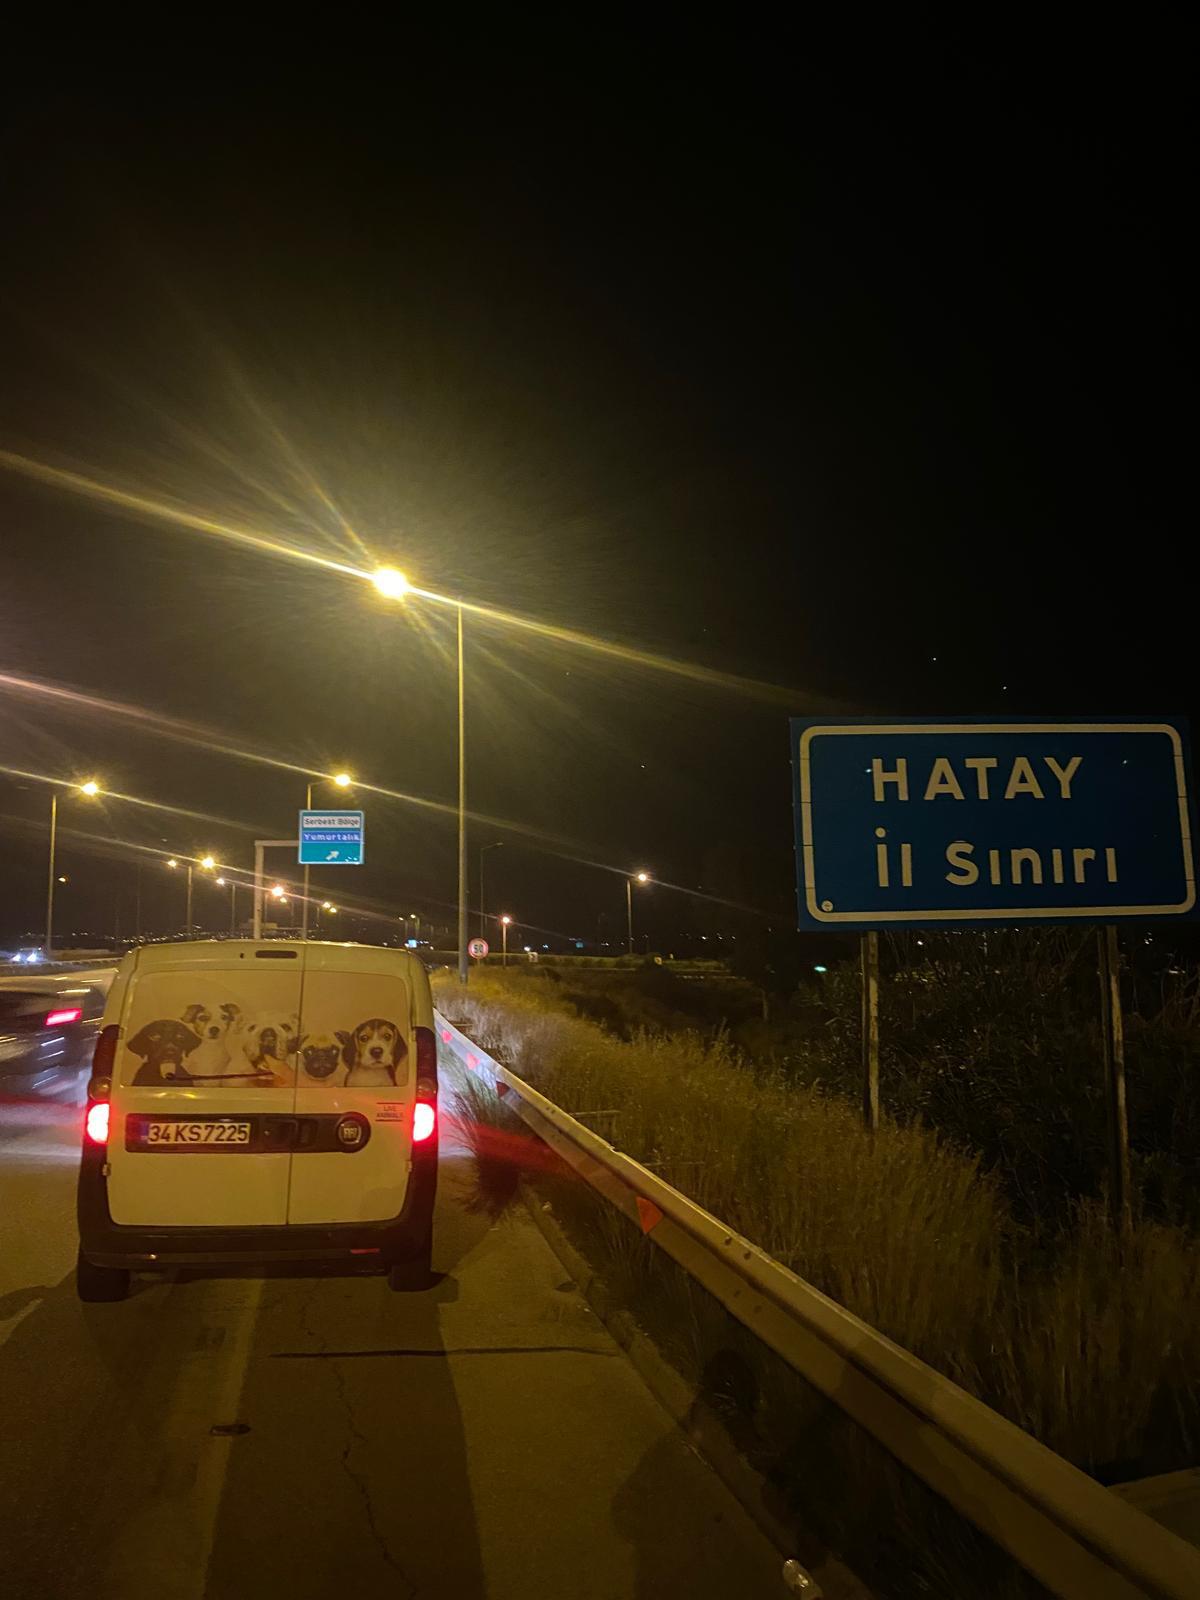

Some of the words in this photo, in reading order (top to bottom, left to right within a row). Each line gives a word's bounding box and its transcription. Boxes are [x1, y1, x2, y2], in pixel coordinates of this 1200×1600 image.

[872, 757, 1082, 801] HATAY
[304, 817, 336, 825] Serbest
[945, 840, 1118, 886] Sınırı
